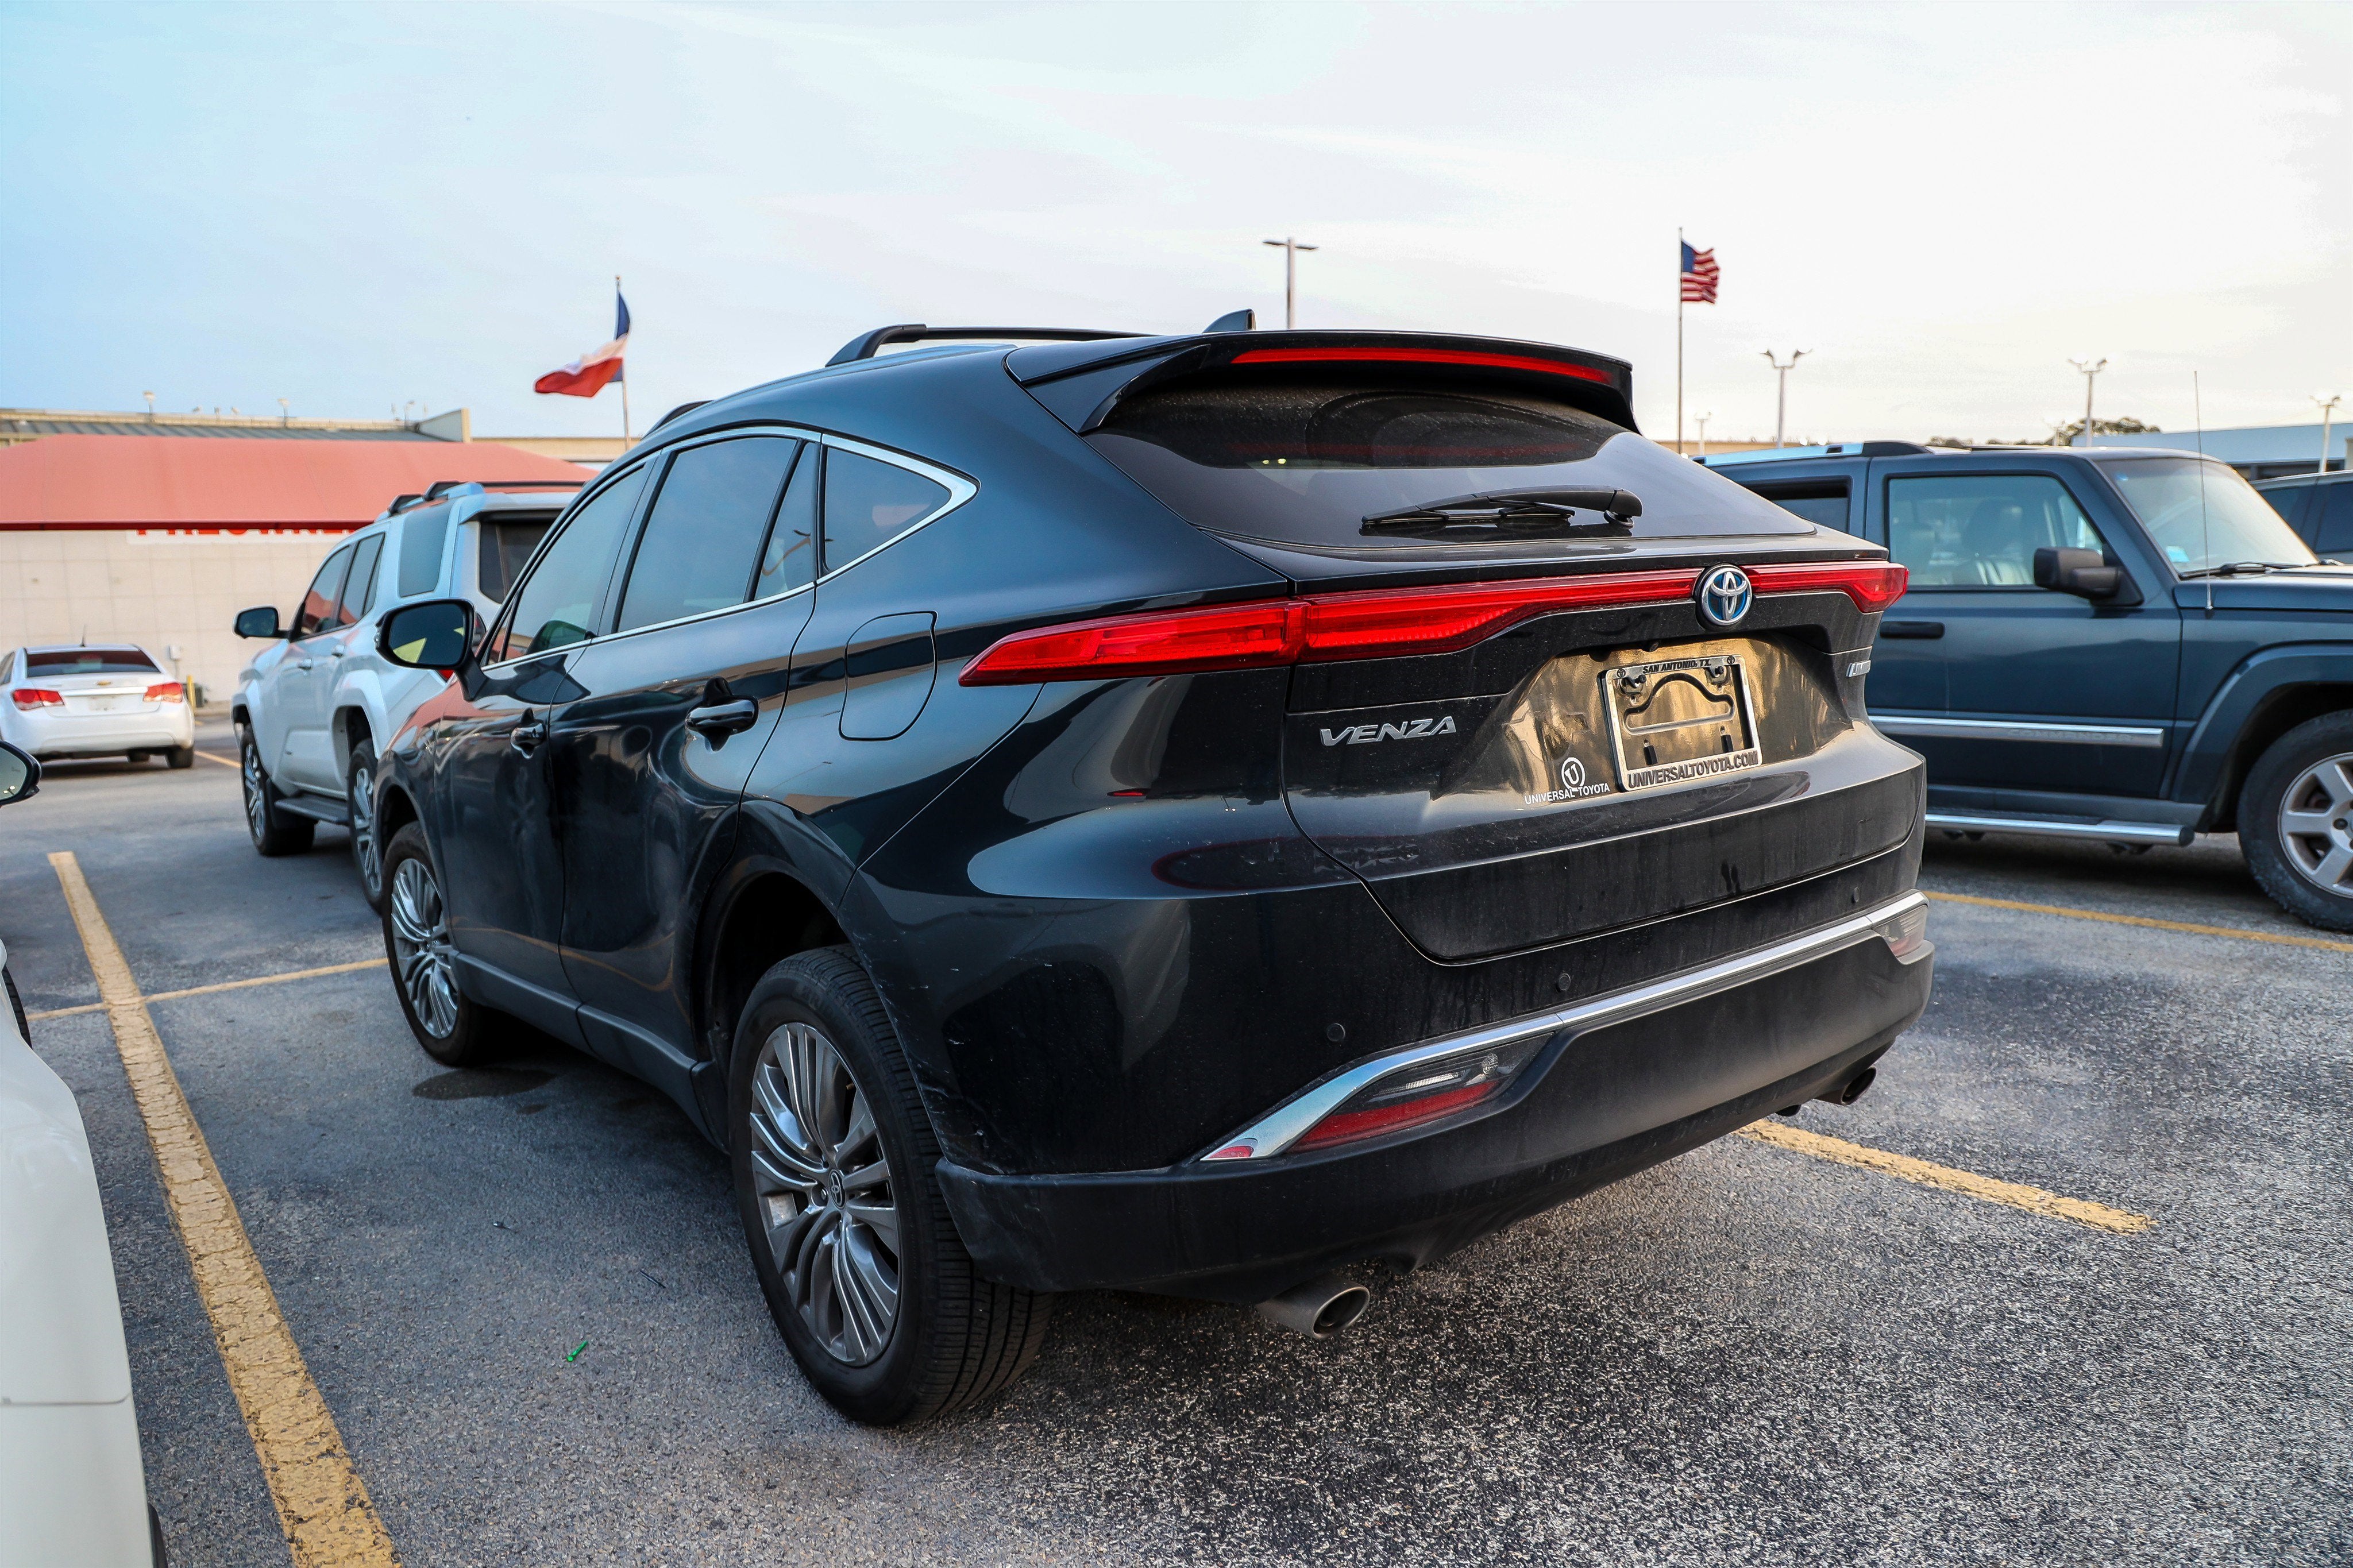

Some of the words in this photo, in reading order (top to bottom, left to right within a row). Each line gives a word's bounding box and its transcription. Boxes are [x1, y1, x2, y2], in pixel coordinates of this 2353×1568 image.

[1642, 664, 1660, 674] SAN
[1320, 716, 1457, 747] VENZA
[1627, 750, 1759, 789] UNIVERSALTOYOTA.COM
[1524, 787, 1576, 805] UNIVERSAL
[1577, 782, 1610, 797] TOYOTA
